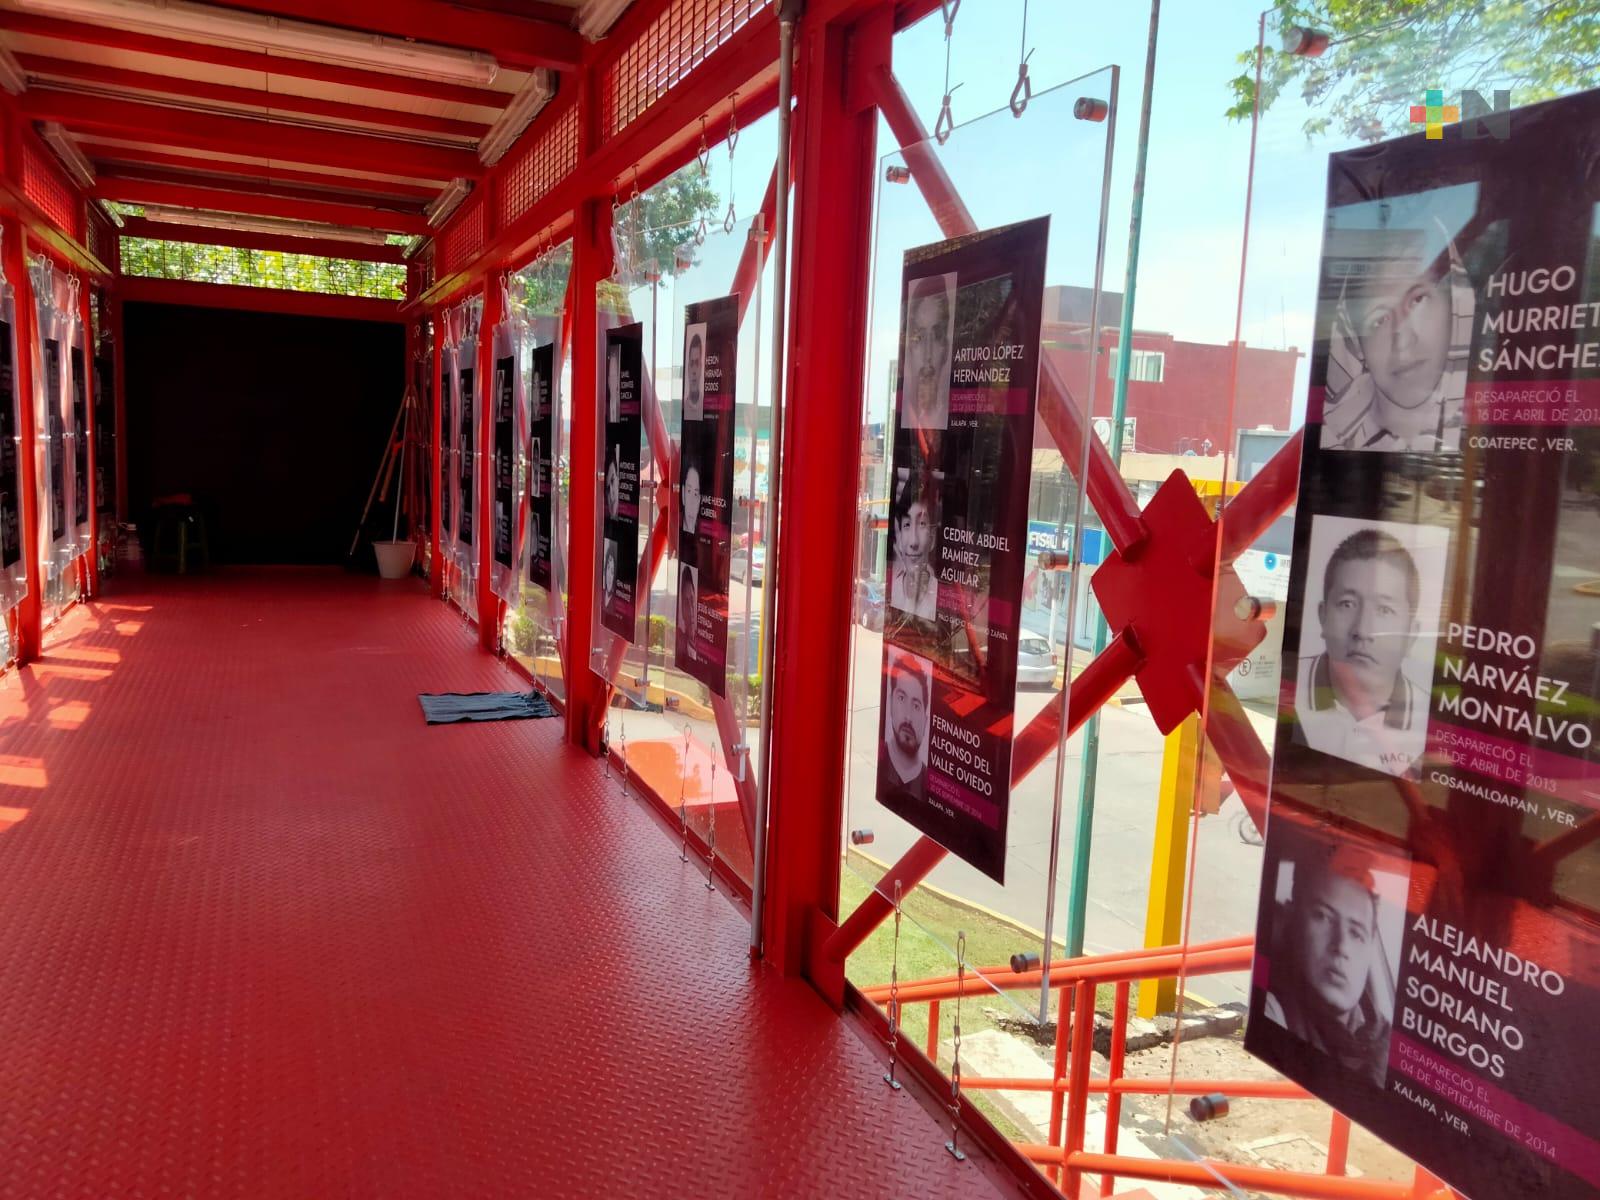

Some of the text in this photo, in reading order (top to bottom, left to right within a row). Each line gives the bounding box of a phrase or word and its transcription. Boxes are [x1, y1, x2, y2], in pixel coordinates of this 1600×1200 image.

[1487, 265, 1576, 298] HUGO
[954, 342, 1025, 362] ARTURO LÓPEZ
[1478, 338, 1600, 372] SÁNCHE
[953, 364, 1011, 383] HERNÁNDEZ
[1474, 387, 1581, 404] DESAPARECIÓ EL
[1493, 409, 1509, 421] DE
[1513, 409, 1546, 422] ABRIL
[1551, 408, 1569, 422] DE
[1468, 436, 1537, 450] COATEPEC
[942, 546, 980, 567] RAMÍREZ
[943, 526, 1010, 553] CEDRIK ABDIEL
[941, 567, 979, 588] AGUILAR
[1447, 622, 1536, 660] PEDRO
[1442, 656, 1570, 706] NARVÁEZ
[932, 714, 981, 749] FERNANDO
[1438, 691, 1592, 748] MONTALVO
[931, 735, 992, 776] ALFONSO DEL
[1435, 729, 1533, 768] DESAPARECIÓ EL
[930, 752, 992, 796] VALLE OVIEDO
[1450, 750, 1467, 765] DE
[1469, 755, 1502, 777] ABRIL
[1505, 766, 1521, 783] DE
[1526, 772, 1557, 793] 2013
[1430, 771, 1538, 815] COSAMALOAPAN
[1412, 913, 1565, 996] ALEJANDRO
[1408, 944, 1514, 1012] MANUEL
[1405, 975, 1524, 1050] SORIANO
[1401, 1006, 1505, 1079] BURGOS
[1398, 1041, 1490, 1102] DESAPARECIÓ EL
[1393, 1080, 1437, 1116] XALAPA
[1400, 1059, 1557, 1158] 04 DE SEPTIEMBRE DE 2014
